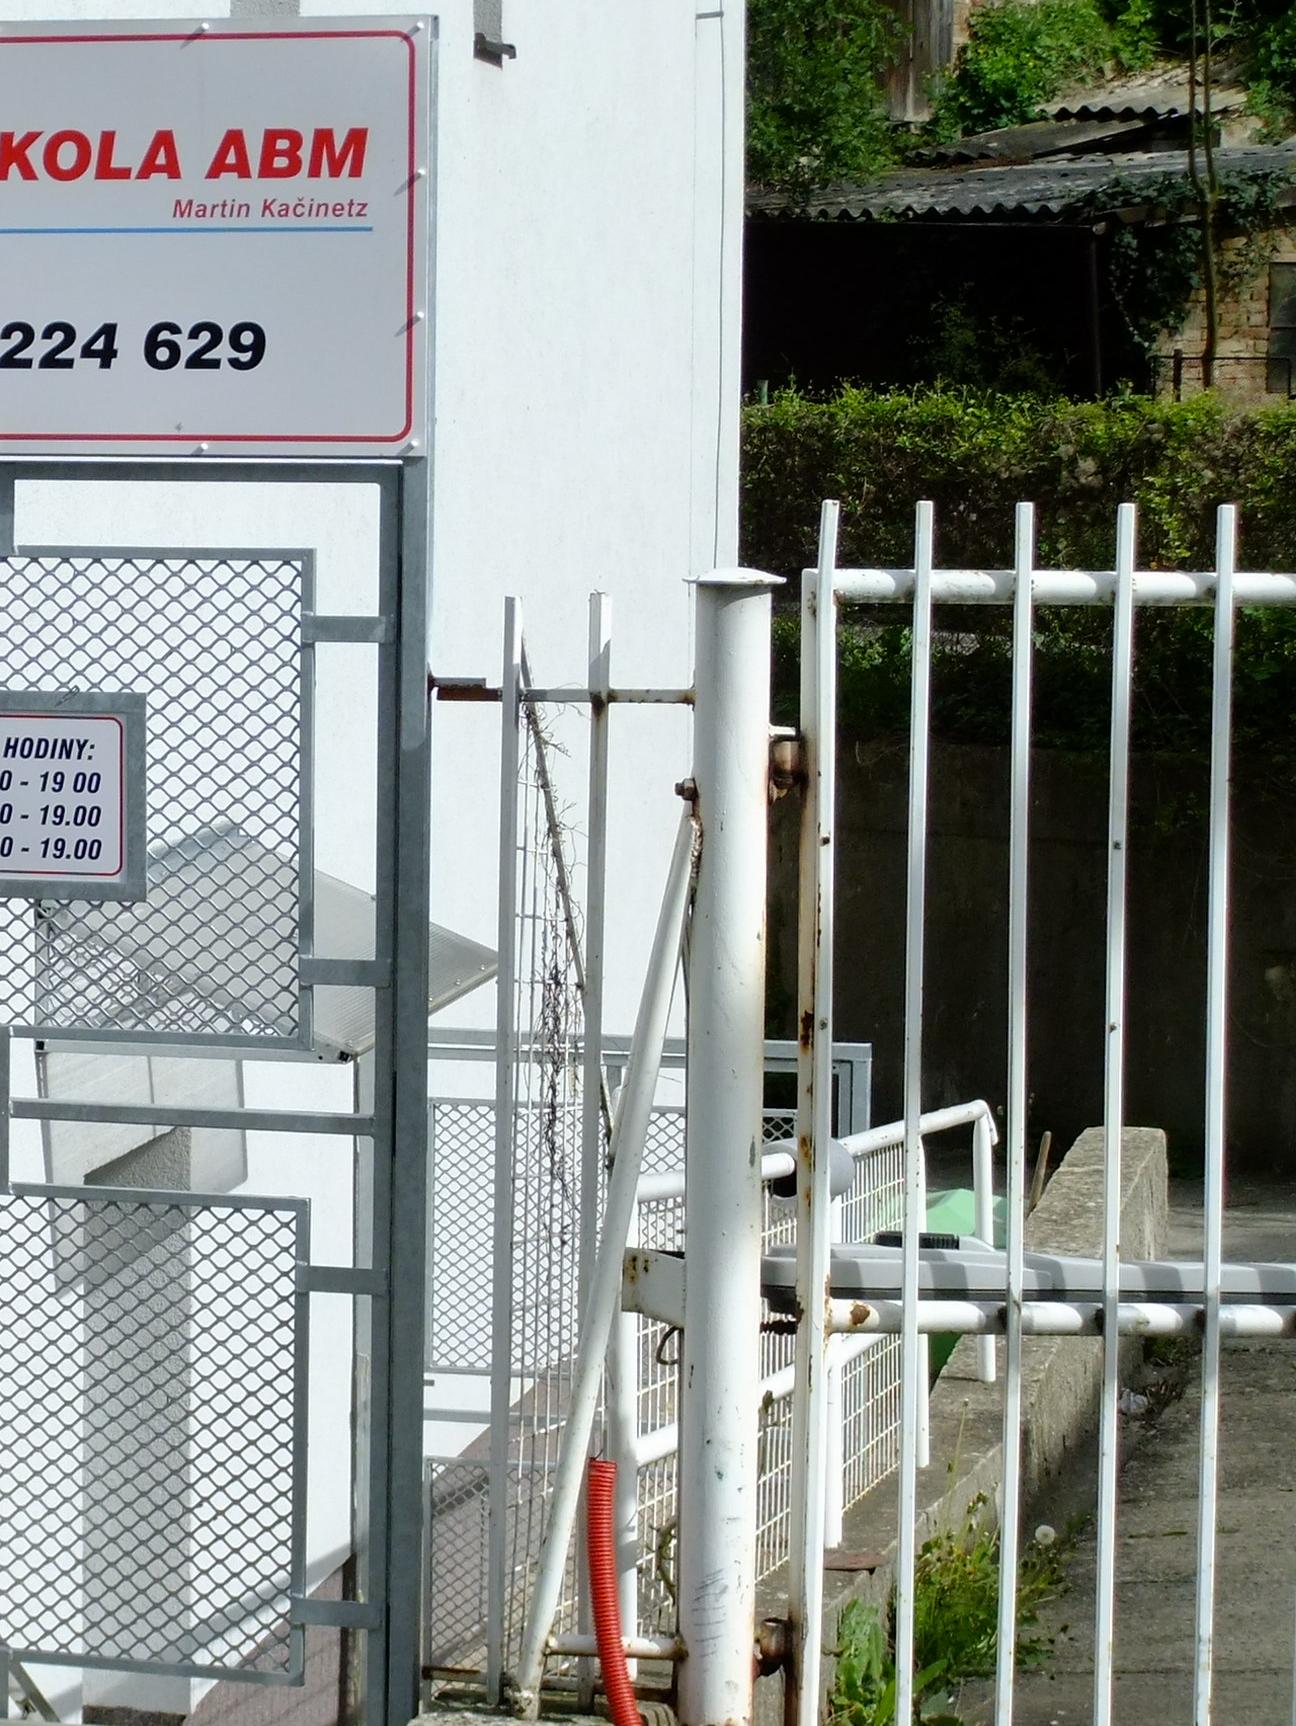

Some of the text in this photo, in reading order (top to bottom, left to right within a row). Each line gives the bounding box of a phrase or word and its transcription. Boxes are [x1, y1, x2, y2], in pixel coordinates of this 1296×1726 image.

[204, 127, 369, 180] ABM
[172, 197, 369, 219] Martin Kačinetz
[143, 321, 267, 371] 629
[2, 736, 95, 761] HODINY:
[39, 804, 102, 828] 19.00
[40, 837, 102, 861] 19.00
